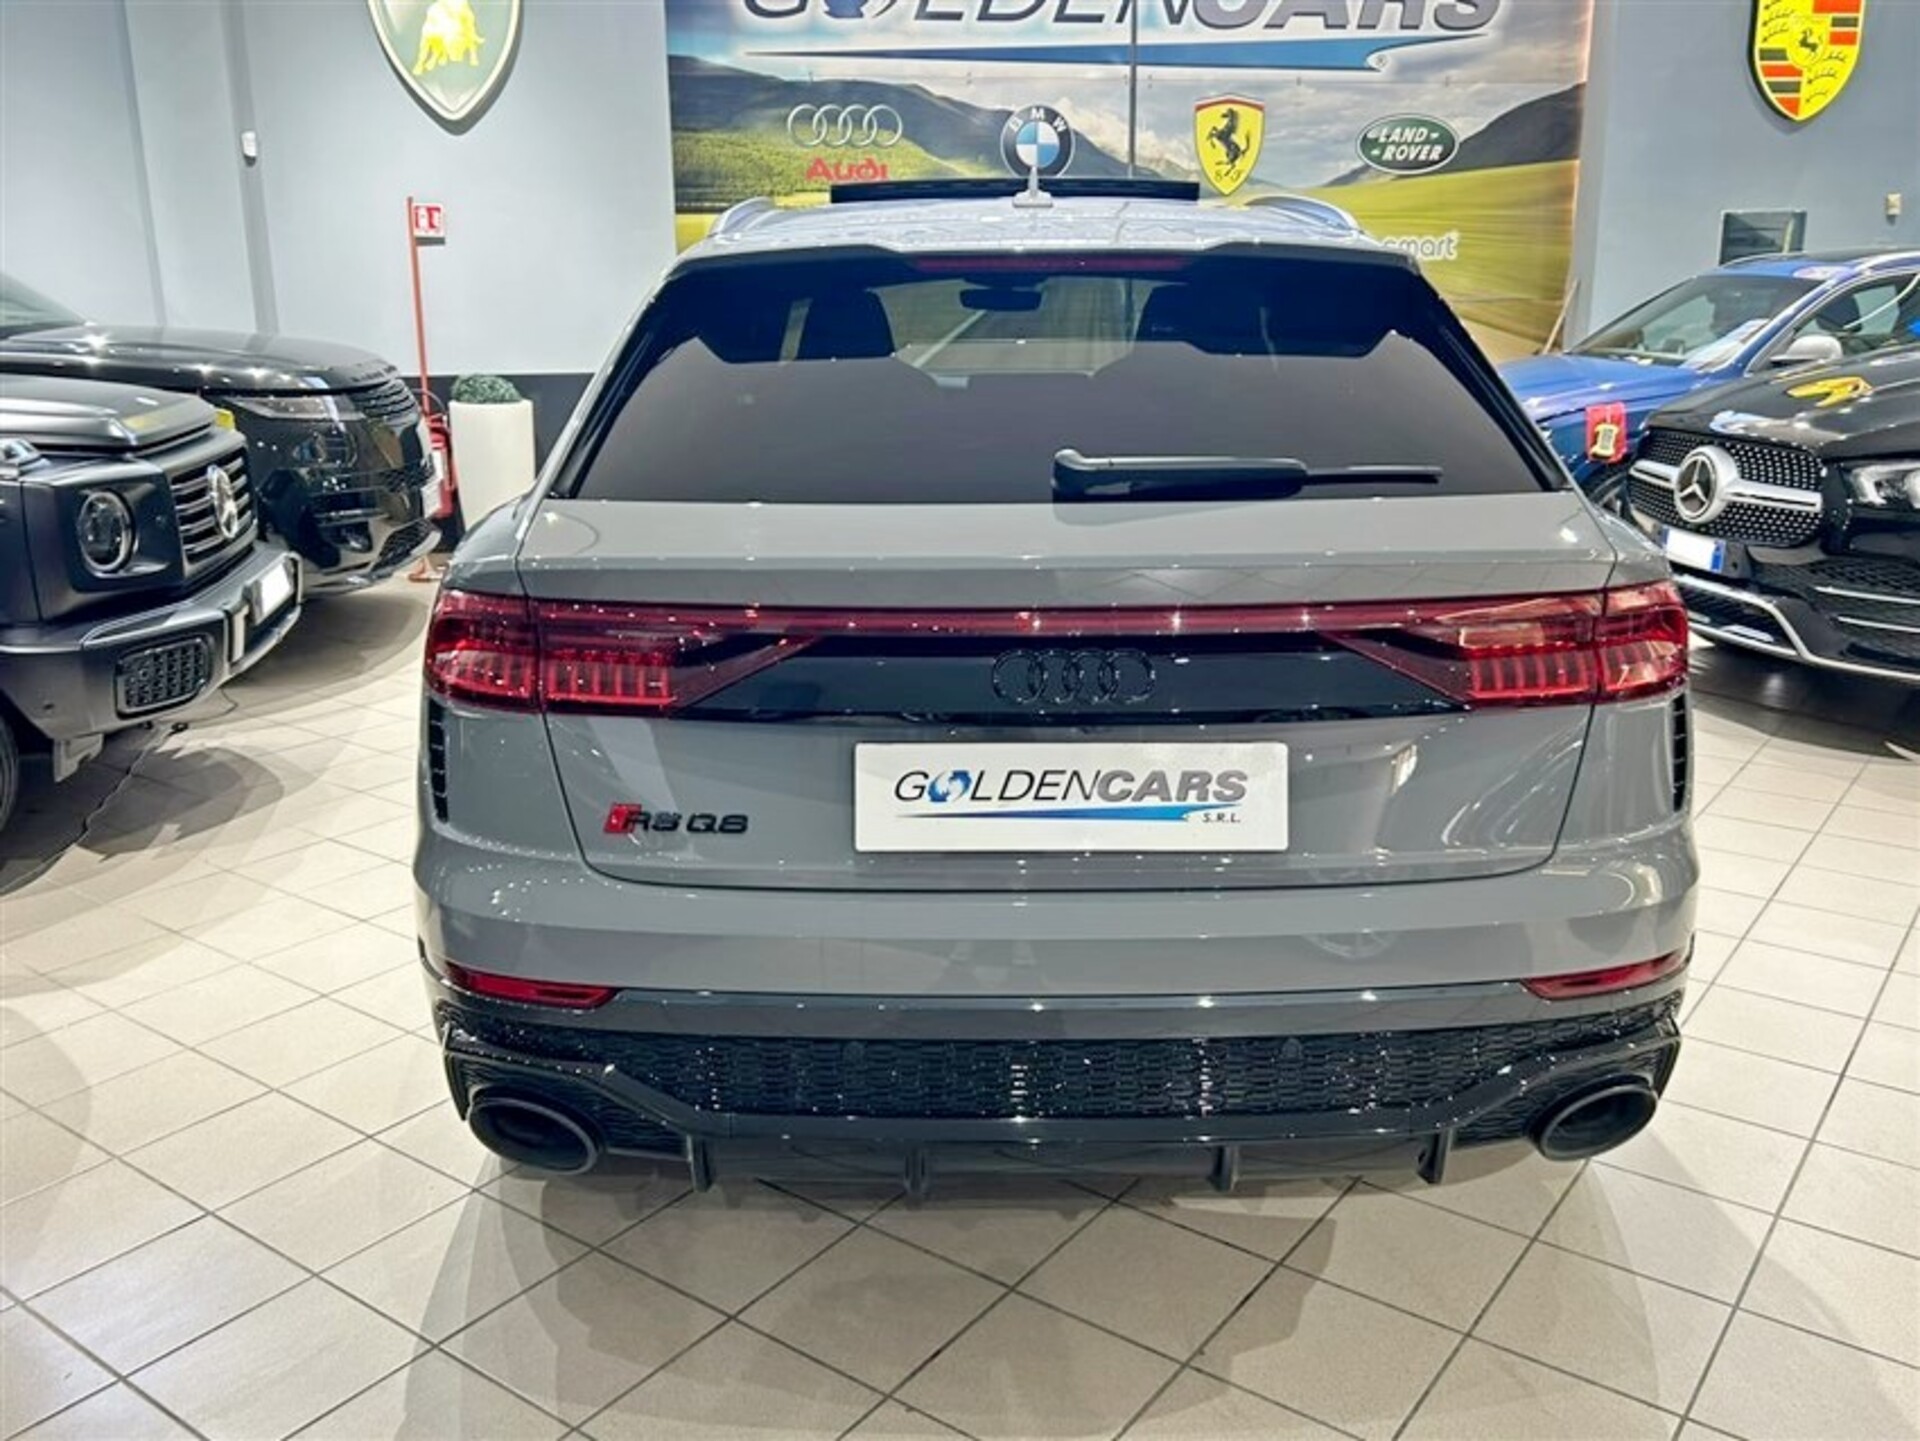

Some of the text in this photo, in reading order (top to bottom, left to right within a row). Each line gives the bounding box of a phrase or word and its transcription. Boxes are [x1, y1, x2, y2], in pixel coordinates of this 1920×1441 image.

[1378, 127, 1428, 143] LAND
[1382, 144, 1444, 161] ROVER
[805, 157, 890, 182] Audi
[686, 813, 749, 834] Q8
[1202, 812, 1242, 824] S.R.L.
